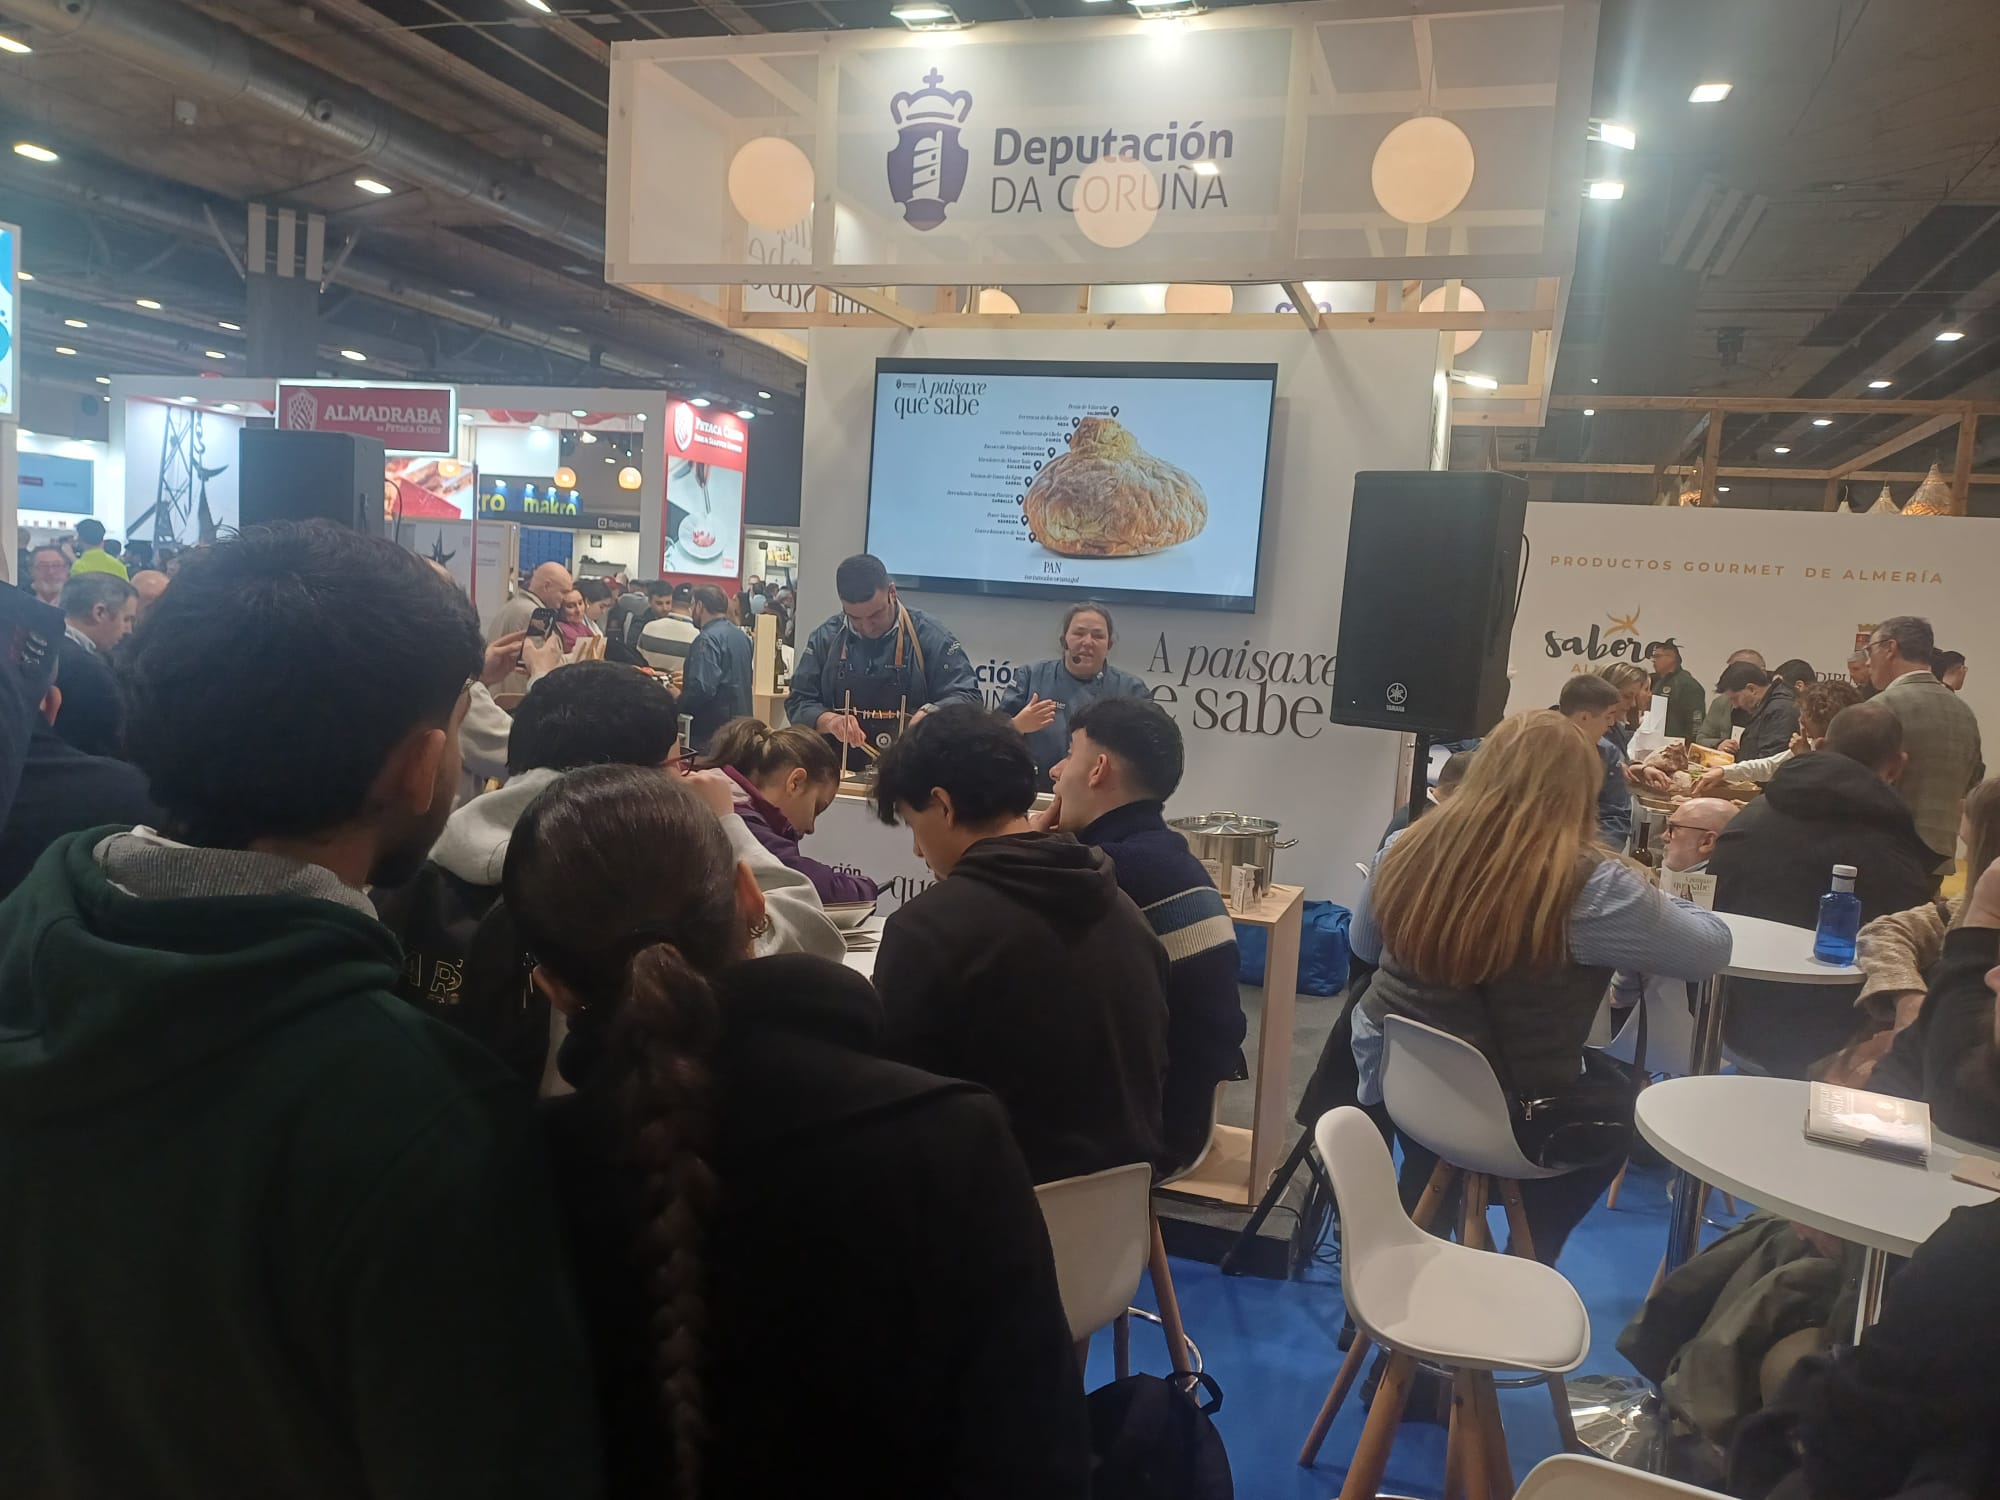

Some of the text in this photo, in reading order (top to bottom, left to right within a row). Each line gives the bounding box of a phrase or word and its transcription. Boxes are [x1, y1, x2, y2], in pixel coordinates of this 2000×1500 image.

[993, 120, 1233, 176] Deputación
[991, 164, 1229, 214] DA CORUÑA
[918, 376, 987, 399] A paisaxe
[324, 404, 443, 425] ALMADRABA
[894, 394, 980, 420] que sabe
[479, 493, 577, 516] ro makro
[1043, 561, 1062, 574] PAN
[1550, 555, 1943, 585] PRODUCTOS GOURMET DE ALMERÍA
[1146, 632, 1337, 687] A paisaxe
[1192, 678, 1324, 739] sabe
